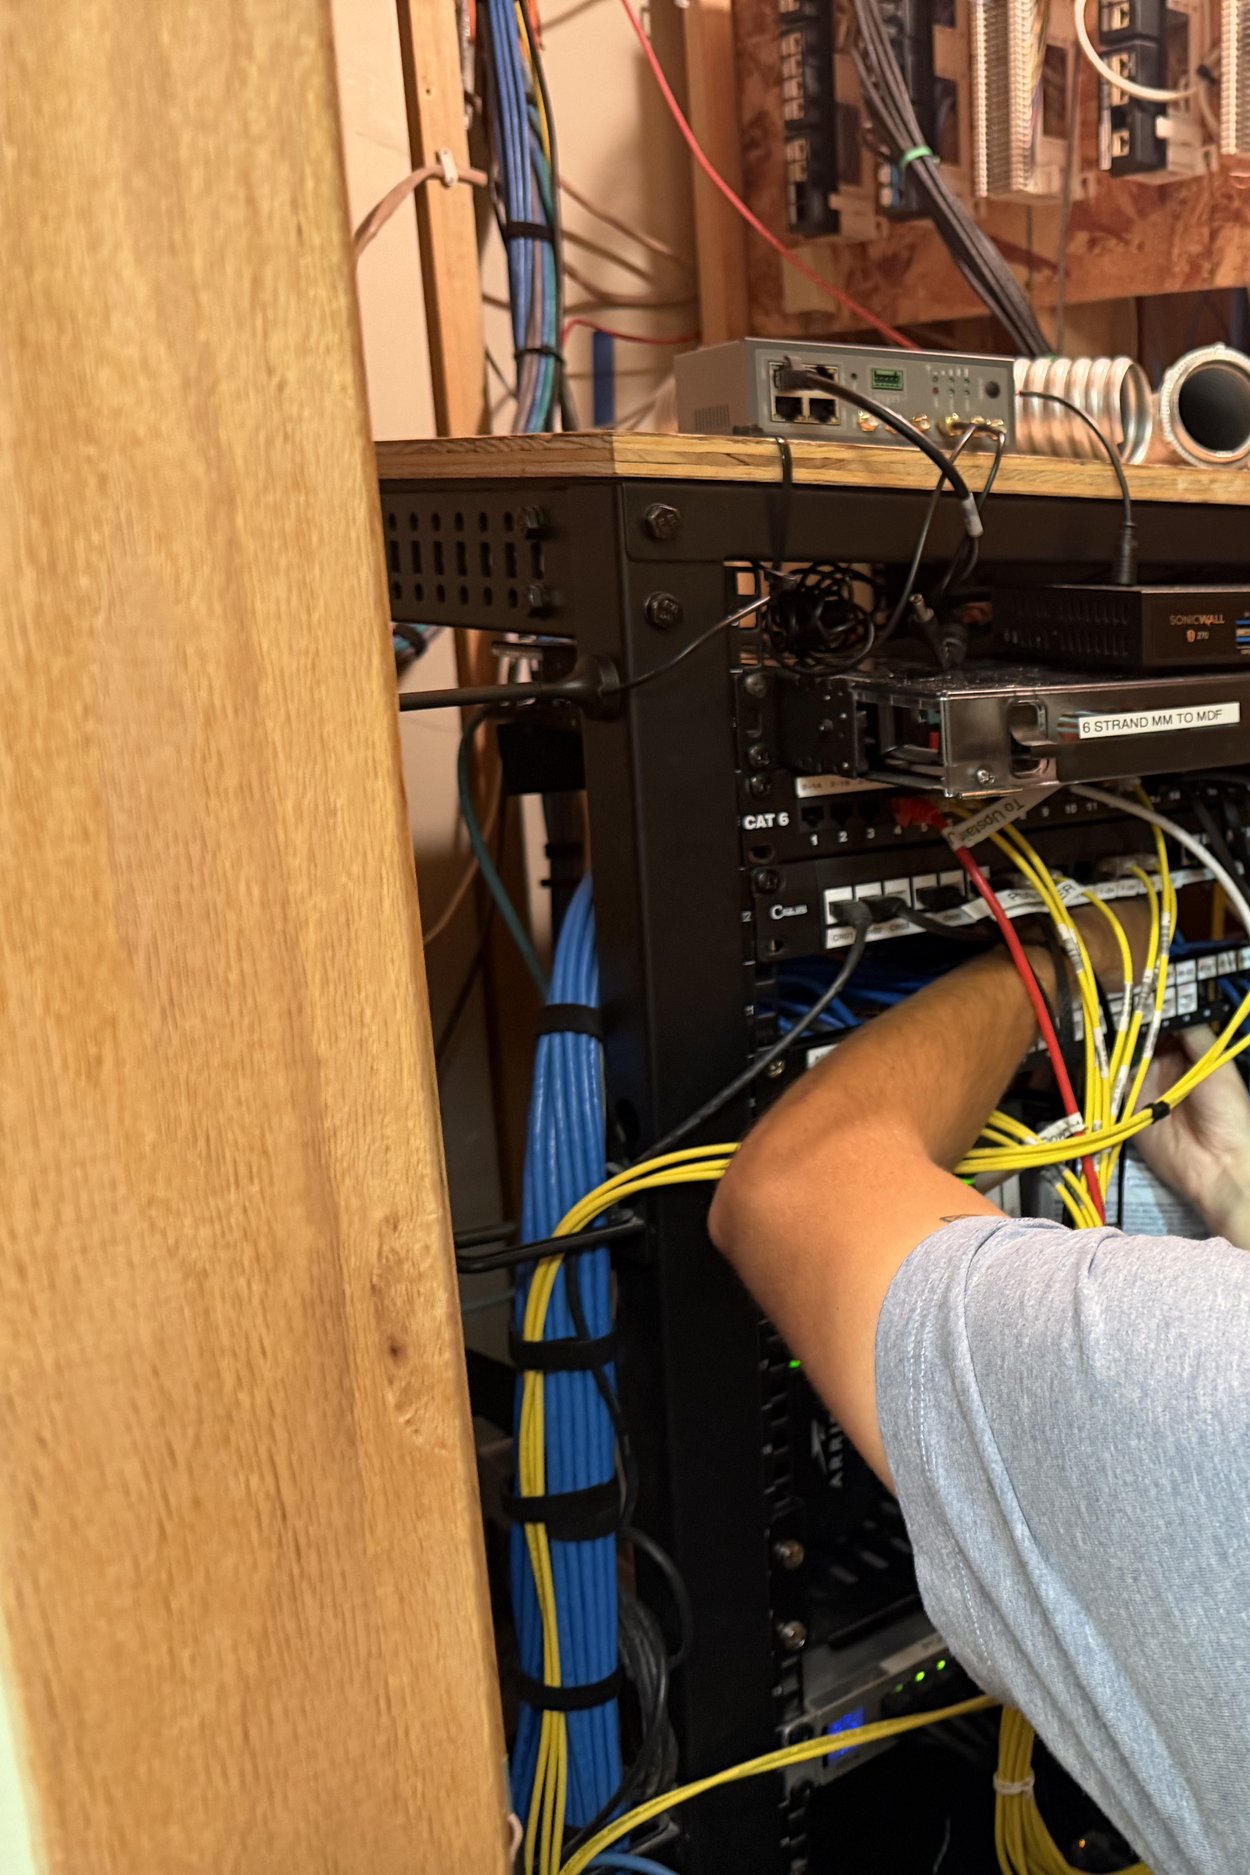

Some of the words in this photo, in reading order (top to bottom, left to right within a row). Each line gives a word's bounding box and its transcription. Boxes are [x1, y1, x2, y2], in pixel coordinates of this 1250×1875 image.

[1169, 614, 1224, 626] SONICWALL
[1082, 721, 1091, 734] 6
[1094, 716, 1149, 733] STRAND
[1152, 714, 1173, 727] MM
[1176, 712, 1194, 724] TO
[1196, 709, 1223, 722] MDF
[1003, 799, 1025, 813] To
[743, 813, 776, 830] CAT
[777, 811, 790, 827] 6
[810, 834, 819, 846] 1
[838, 830, 848, 843] 2
[866, 827, 876, 839] 3
[829, 1415, 843, 1488] ARRI
